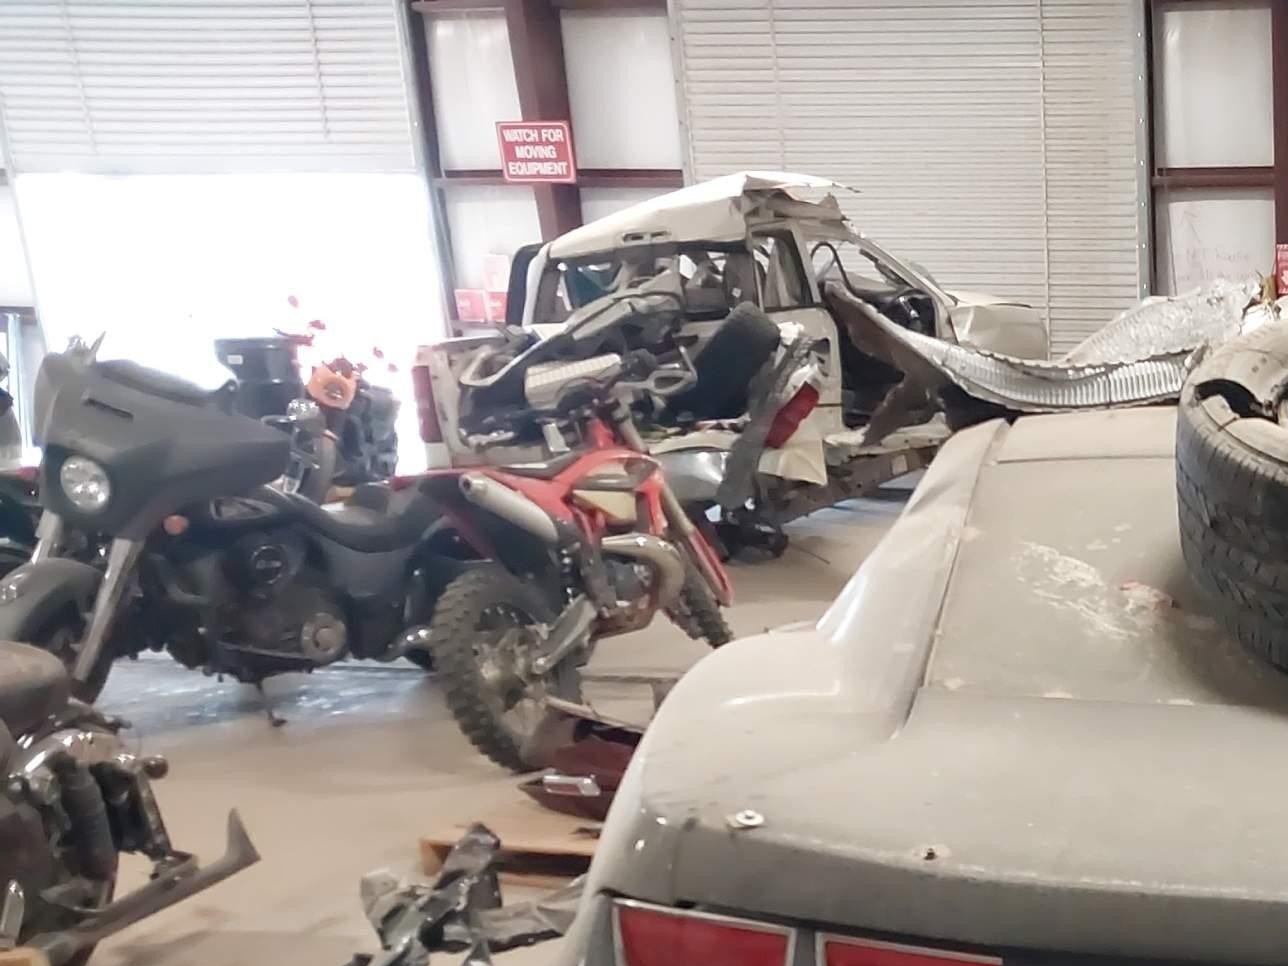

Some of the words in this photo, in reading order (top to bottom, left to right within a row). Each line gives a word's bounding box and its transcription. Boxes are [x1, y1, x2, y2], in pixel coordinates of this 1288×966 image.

[502, 128, 539, 142] WATCH
[541, 129, 564, 142] FOR
[514, 144, 558, 159] MOVING
[508, 161, 568, 176] EQUIPMENT
